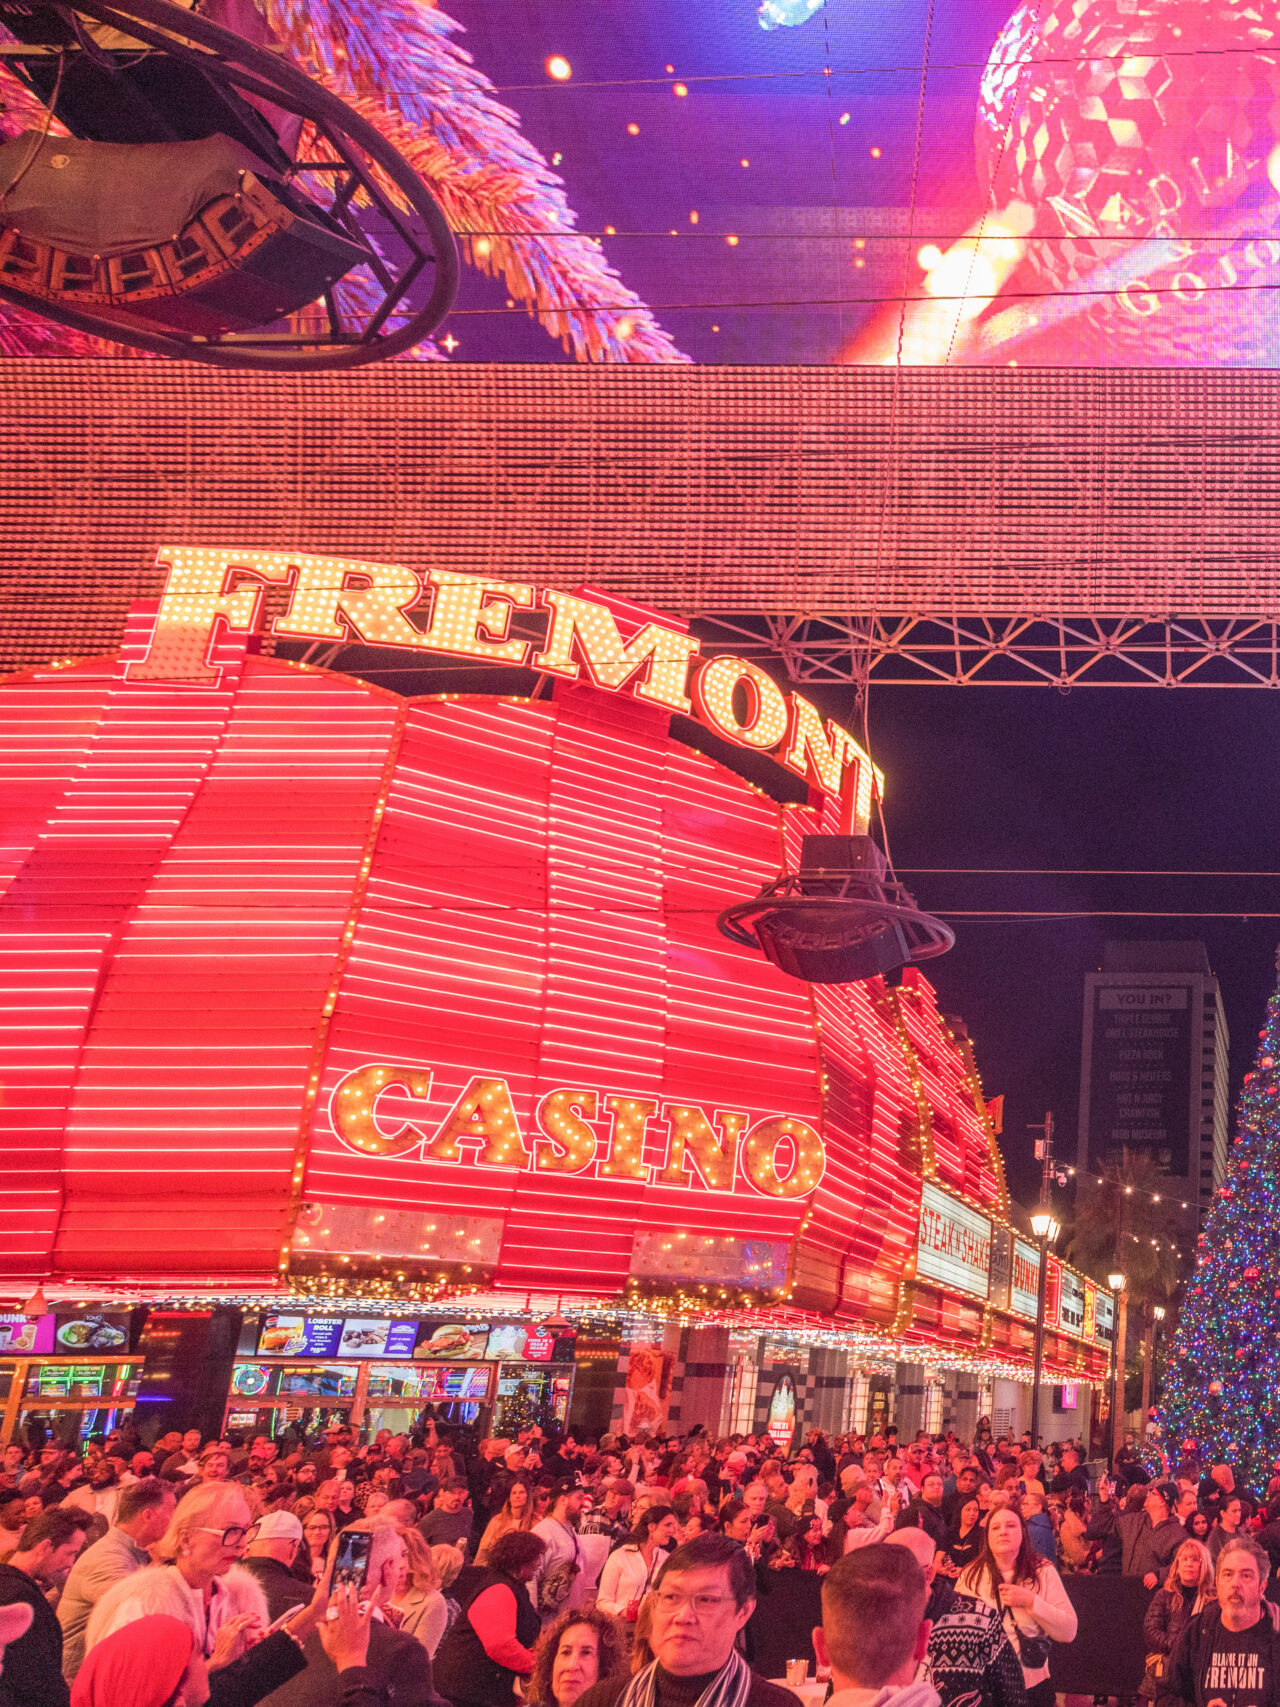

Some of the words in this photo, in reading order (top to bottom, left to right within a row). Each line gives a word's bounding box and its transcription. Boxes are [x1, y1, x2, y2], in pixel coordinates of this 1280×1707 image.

[124, 545, 885, 834] FREMONT
[1117, 993, 1146, 1005] YOU
[1150, 993, 1172, 1005] IN?
[1119, 1049, 1141, 1060] PIZZA
[329, 1063, 826, 1199] CASINO
[920, 1207, 955, 1257] STEAK
[961, 1228, 990, 1273] SHAKE
[1212, 1652, 1236, 1667] BLAME
[1238, 1653, 1246, 1667] IT
